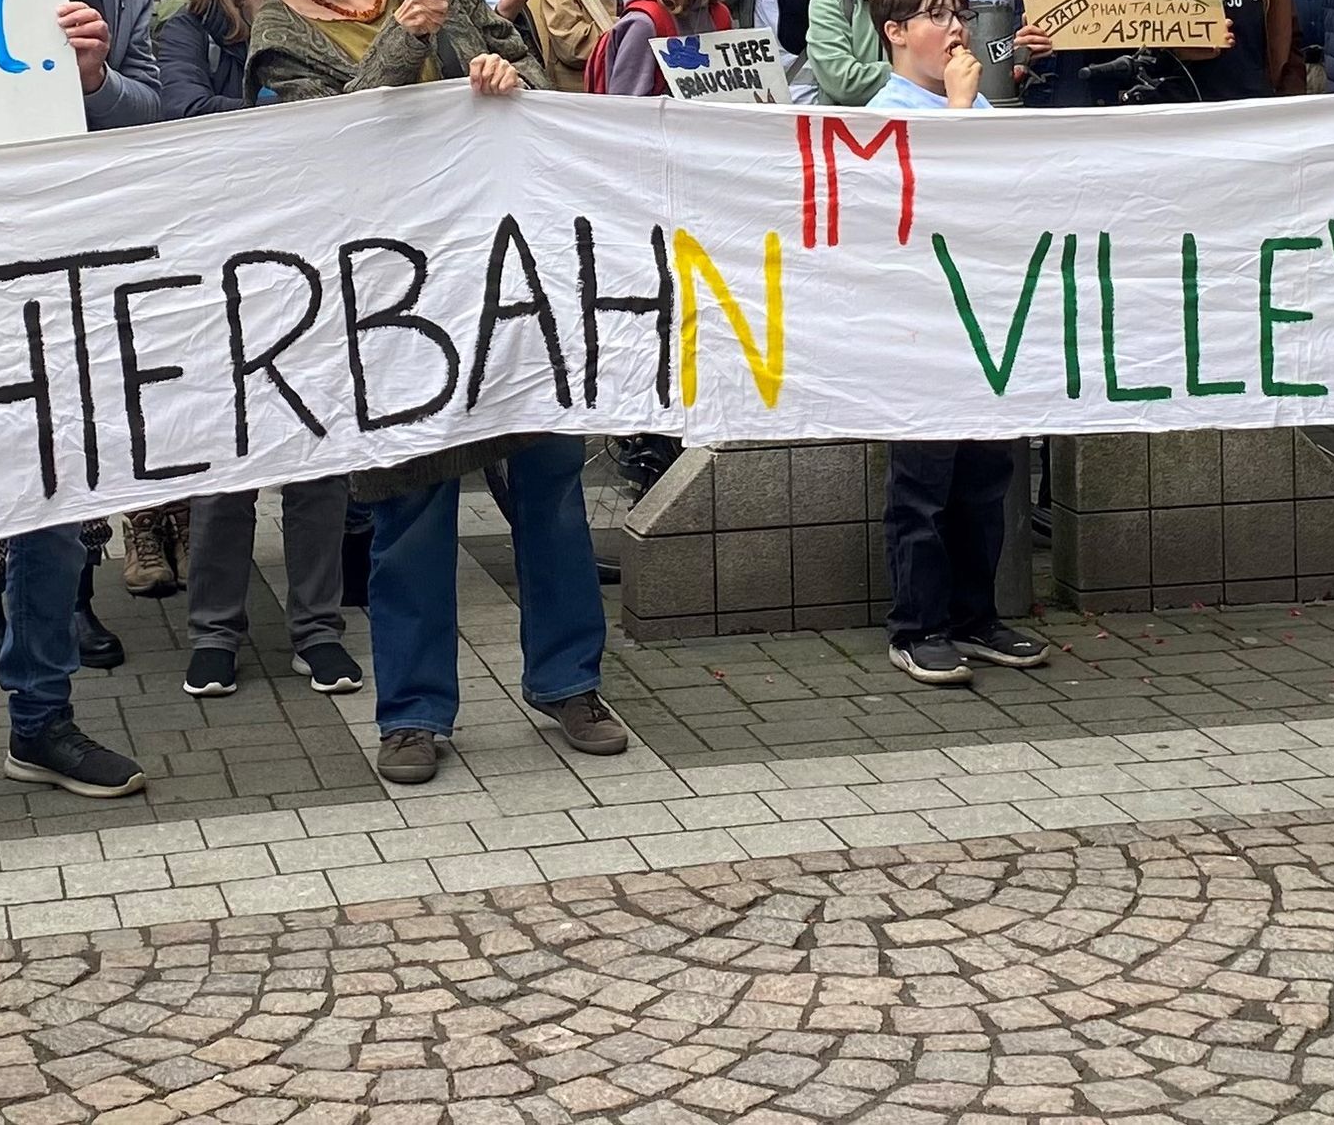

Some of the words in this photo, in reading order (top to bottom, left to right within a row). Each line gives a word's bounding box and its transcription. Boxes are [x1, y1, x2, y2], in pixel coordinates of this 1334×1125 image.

[1045, 0, 1086, 32] STATT
[1089, 1, 1207, 19] PHANTALAND
[1102, 19, 1218, 44] ASPHALT
[714, 38, 775, 68] TIERE
[675, 66, 763, 100] BRAUCHEN
[798, 115, 912, 248] IM
